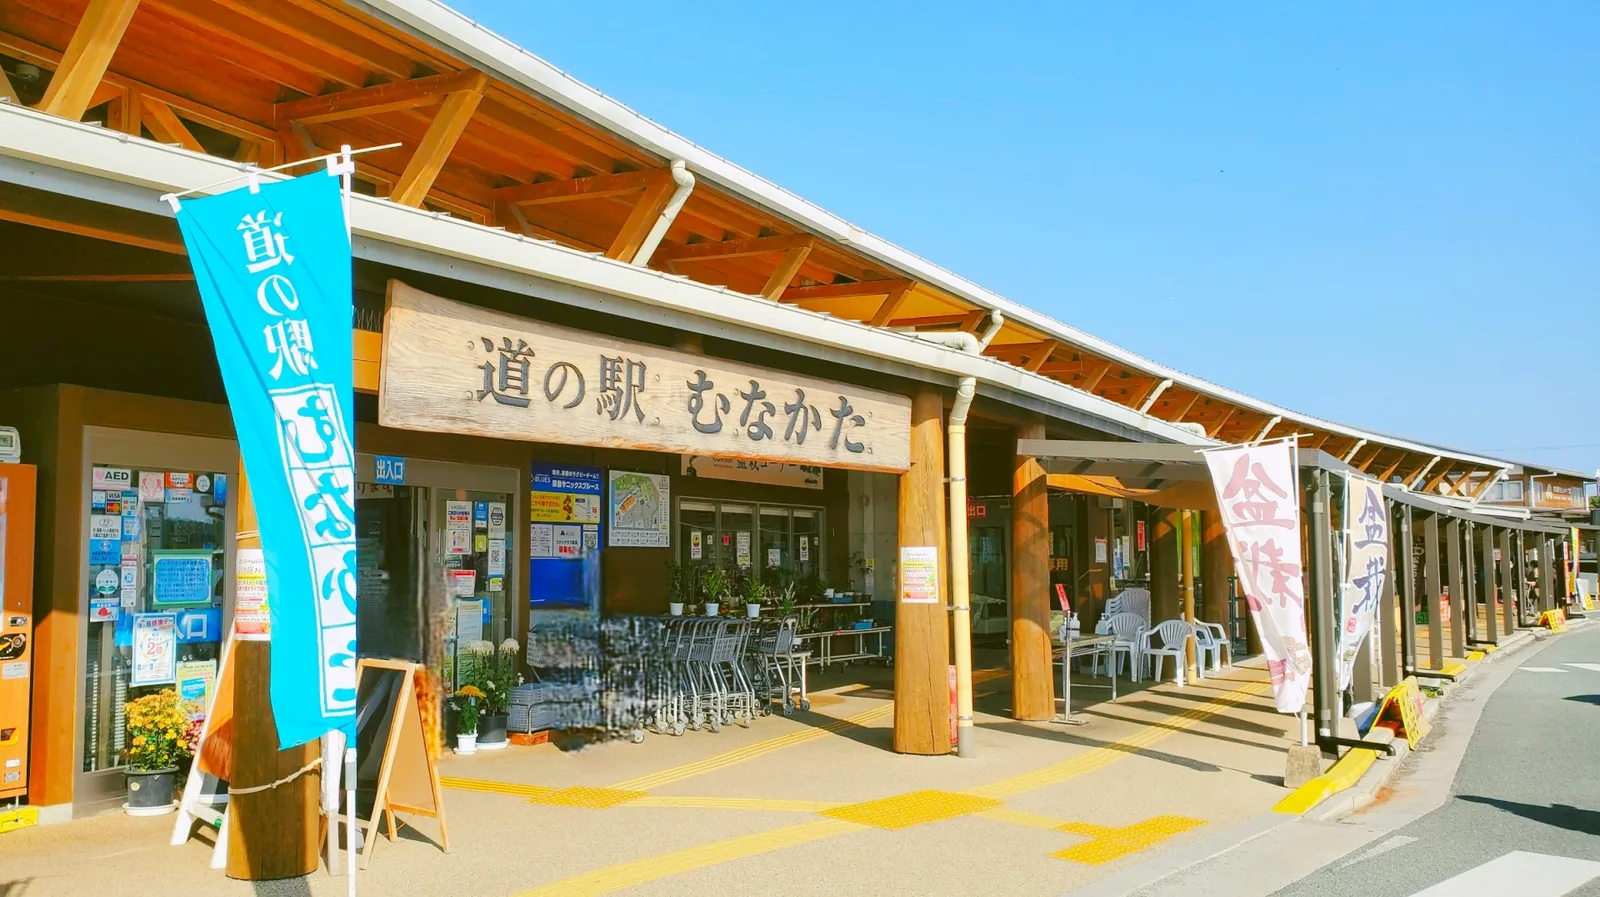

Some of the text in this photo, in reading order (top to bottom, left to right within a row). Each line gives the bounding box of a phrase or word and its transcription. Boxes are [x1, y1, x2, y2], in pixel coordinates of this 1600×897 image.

[475, 335, 867, 454] 道の駅 むなかた
[105, 471, 128, 481] AED
[375, 458, 404, 481] 出入口
[1352, 486, 1388, 617] 盆栽
